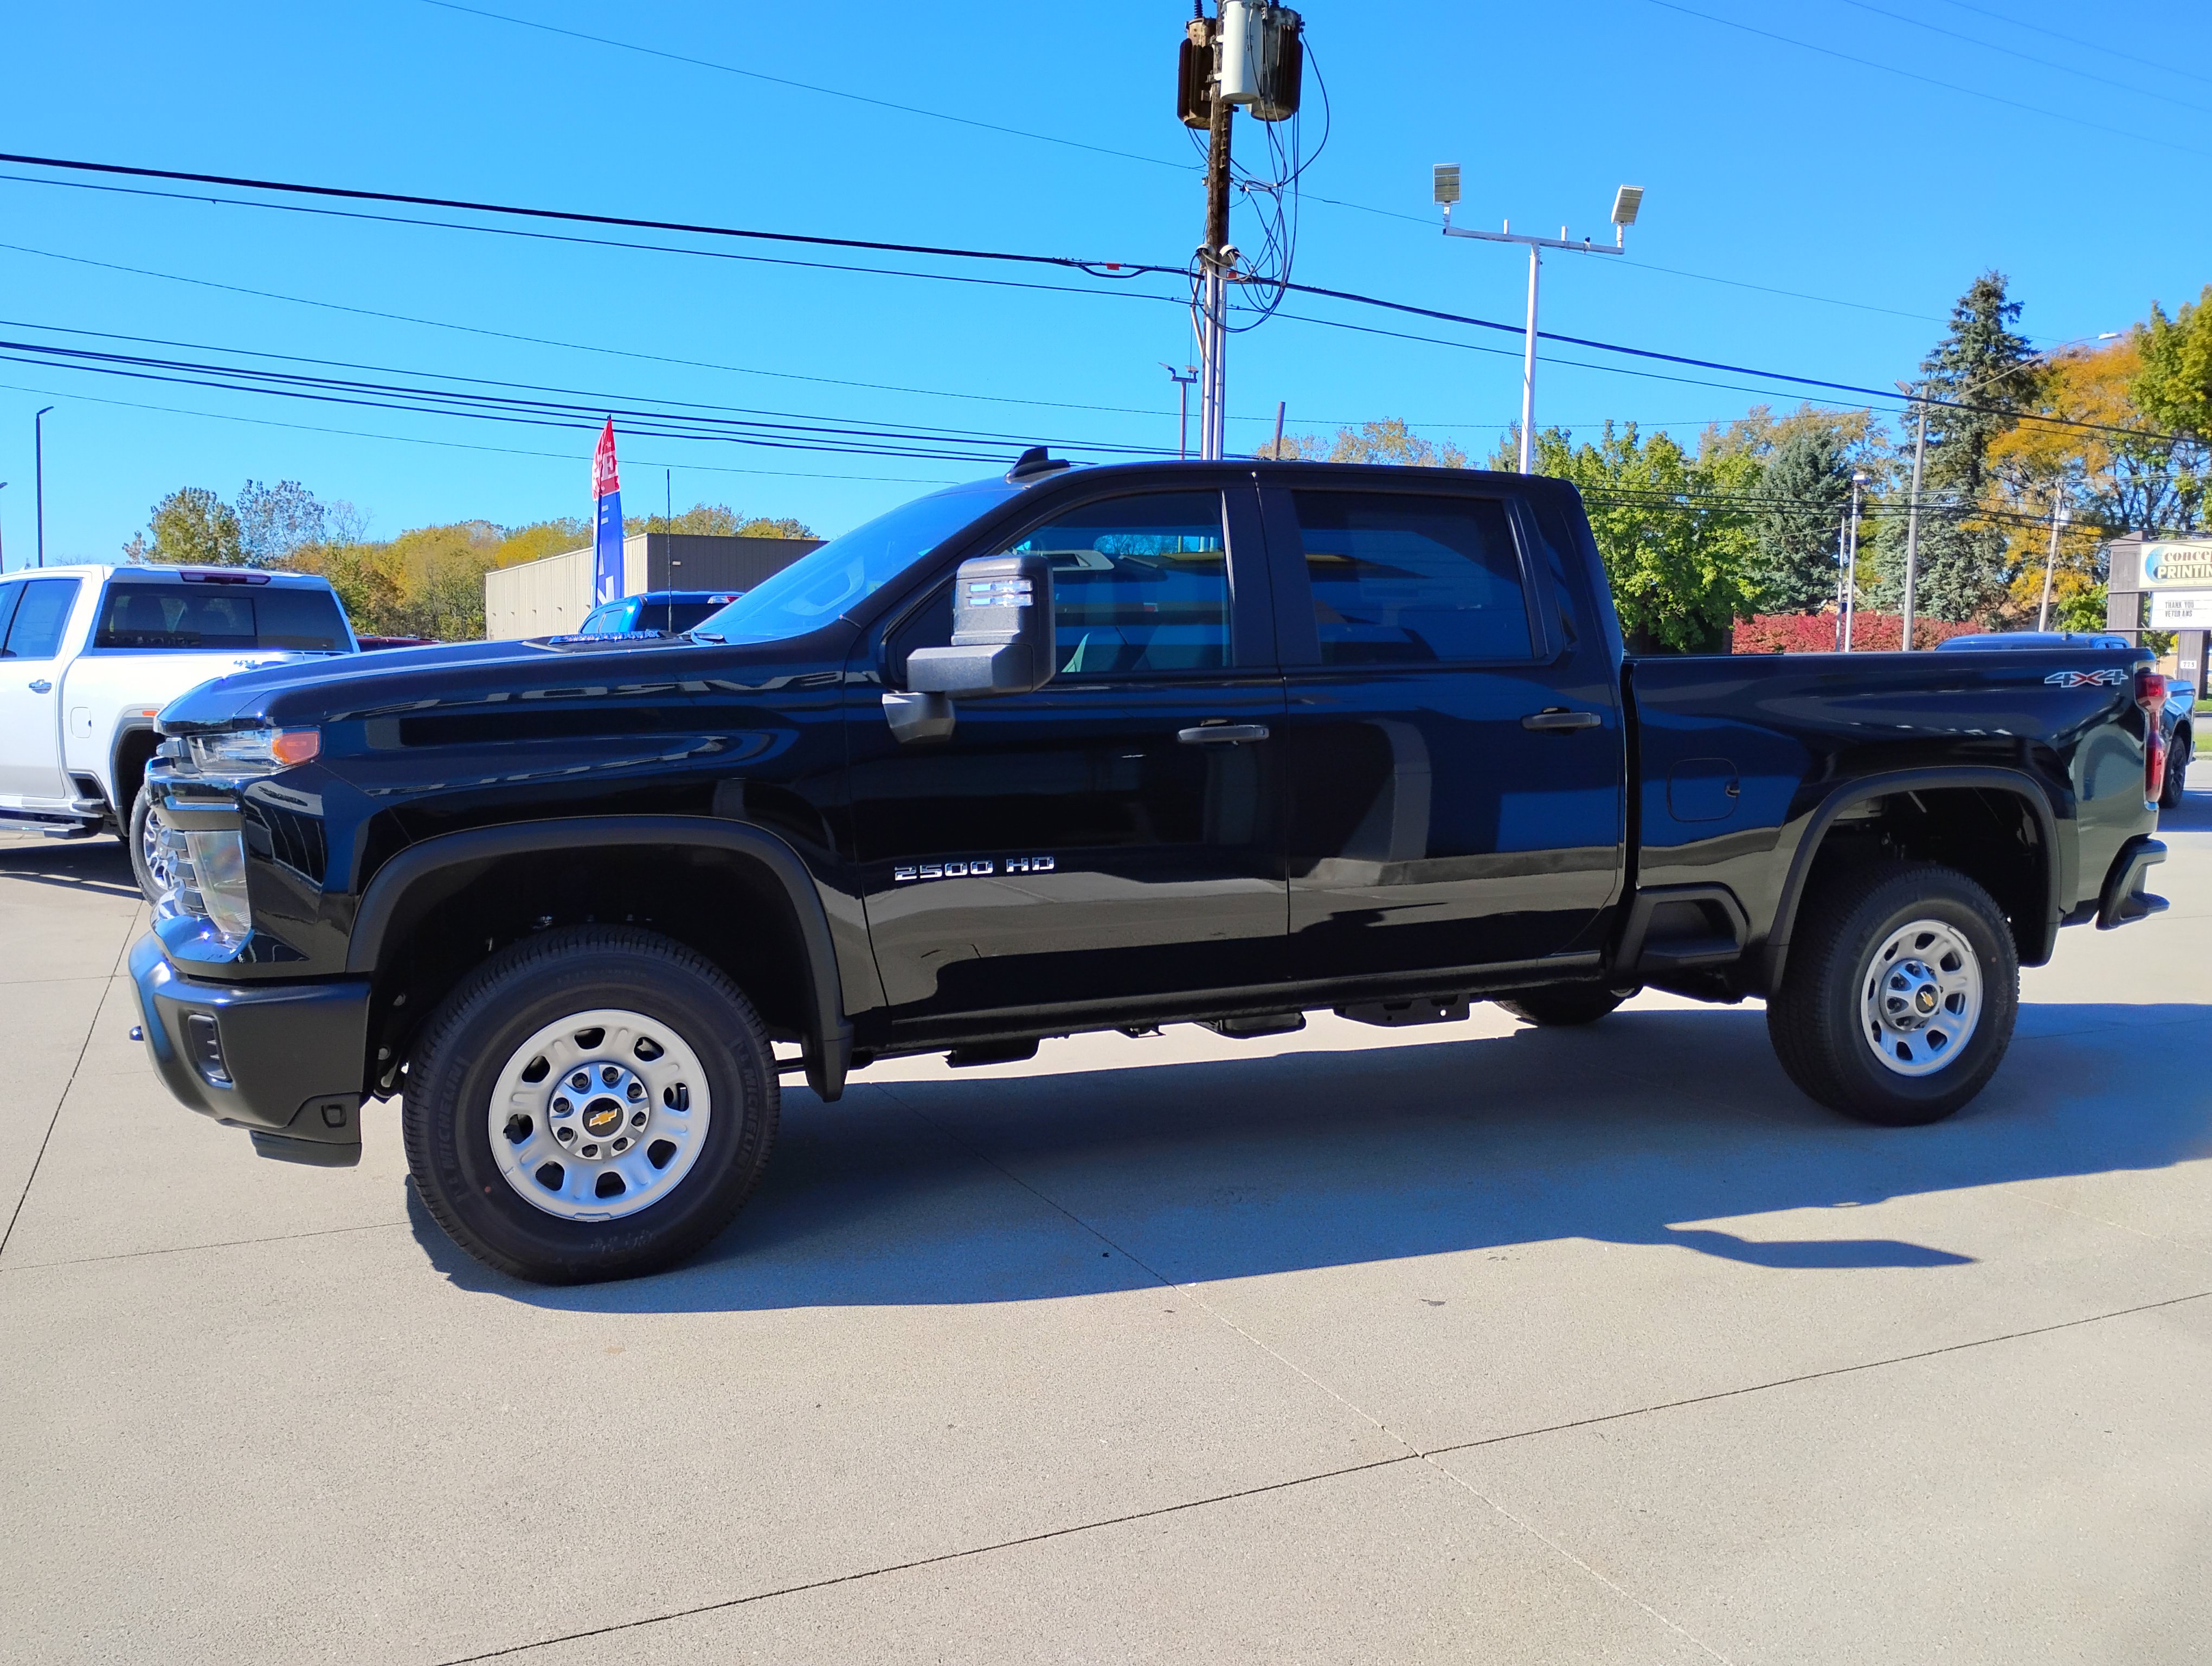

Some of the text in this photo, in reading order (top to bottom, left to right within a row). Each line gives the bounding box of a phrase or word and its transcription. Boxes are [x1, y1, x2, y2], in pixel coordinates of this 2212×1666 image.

[2164, 551, 2212, 563] conce
[895, 856, 1054, 881] 2500 HD
